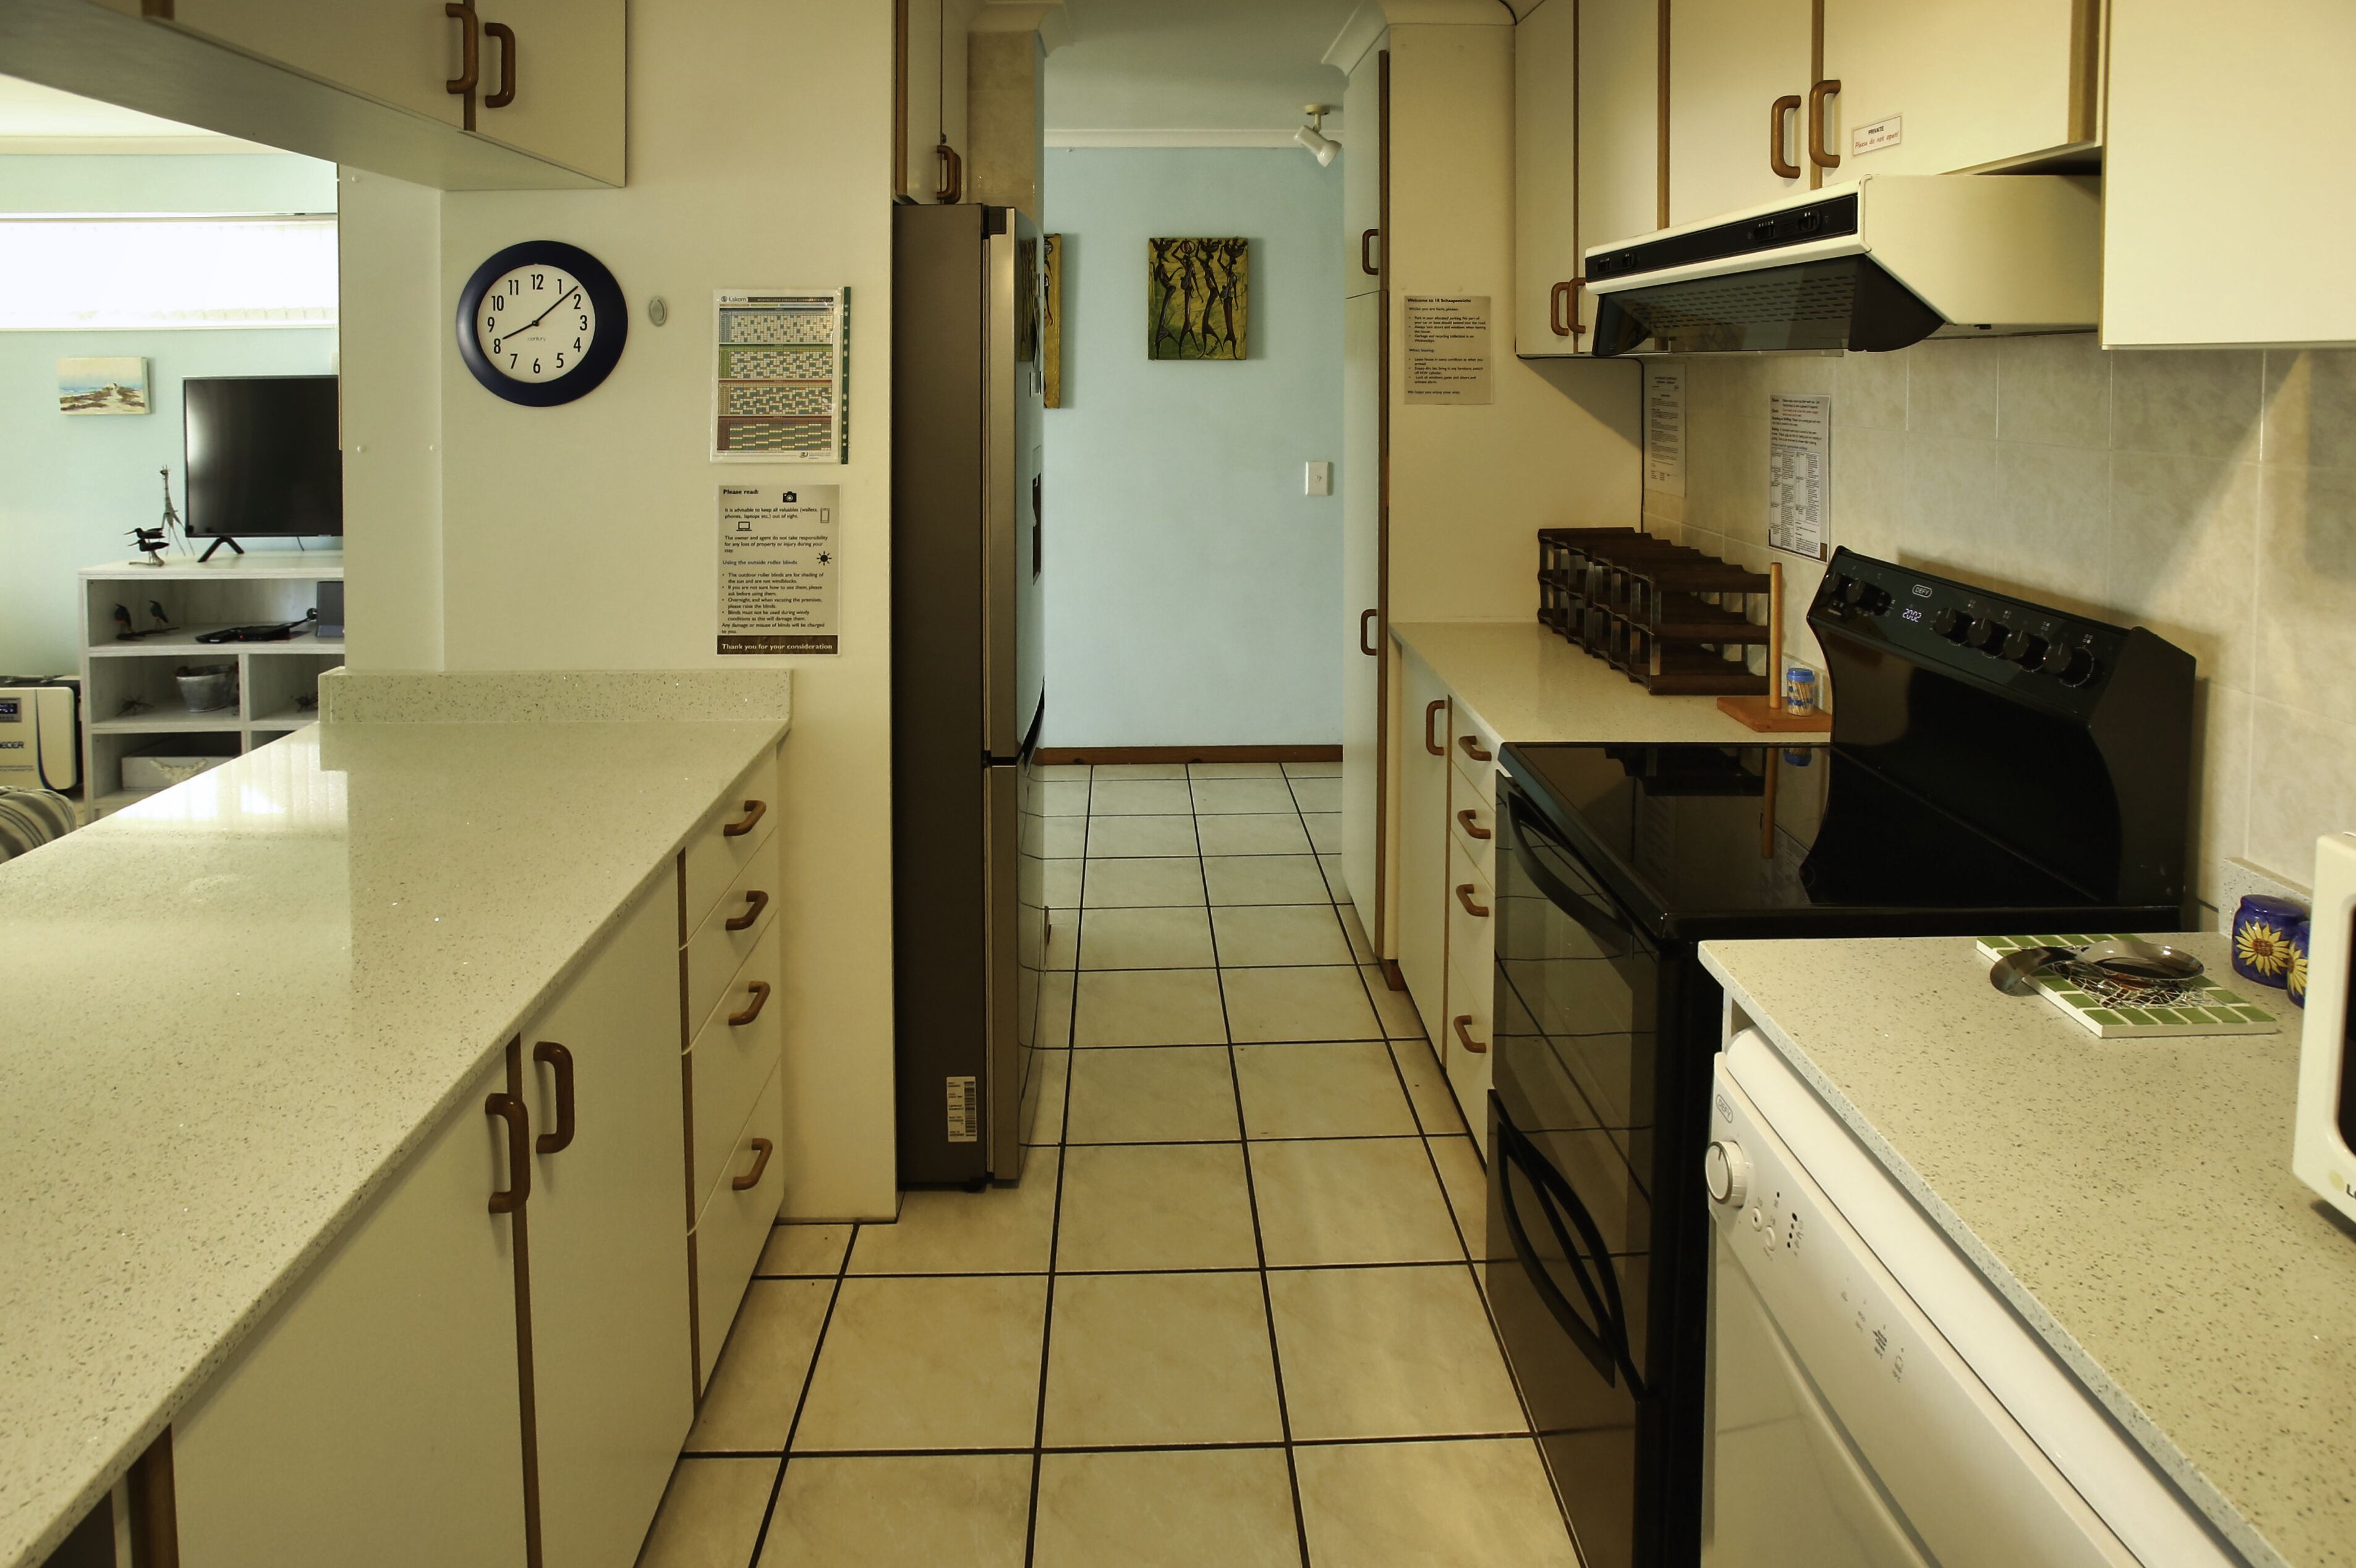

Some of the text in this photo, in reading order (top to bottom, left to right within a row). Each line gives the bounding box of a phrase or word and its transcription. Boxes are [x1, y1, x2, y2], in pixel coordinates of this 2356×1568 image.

[1868, 125, 1884, 135] PRIVATE
[508, 280, 519, 295] 11
[531, 274, 544, 290] 12
[557, 279, 563, 294] 1
[491, 295, 504, 311] 10
[573, 294, 581, 310] 2
[487, 317, 495, 333] 9
[580, 315, 588, 331] 3
[493, 338, 501, 354] 8
[573, 337, 582, 352] 4
[510, 354, 518, 370] 7
[533, 358, 541, 374] 6
[556, 353, 564, 368] 5
[1915, 587, 1929, 596] DEFY
[0, 741, 25, 749] ECER
